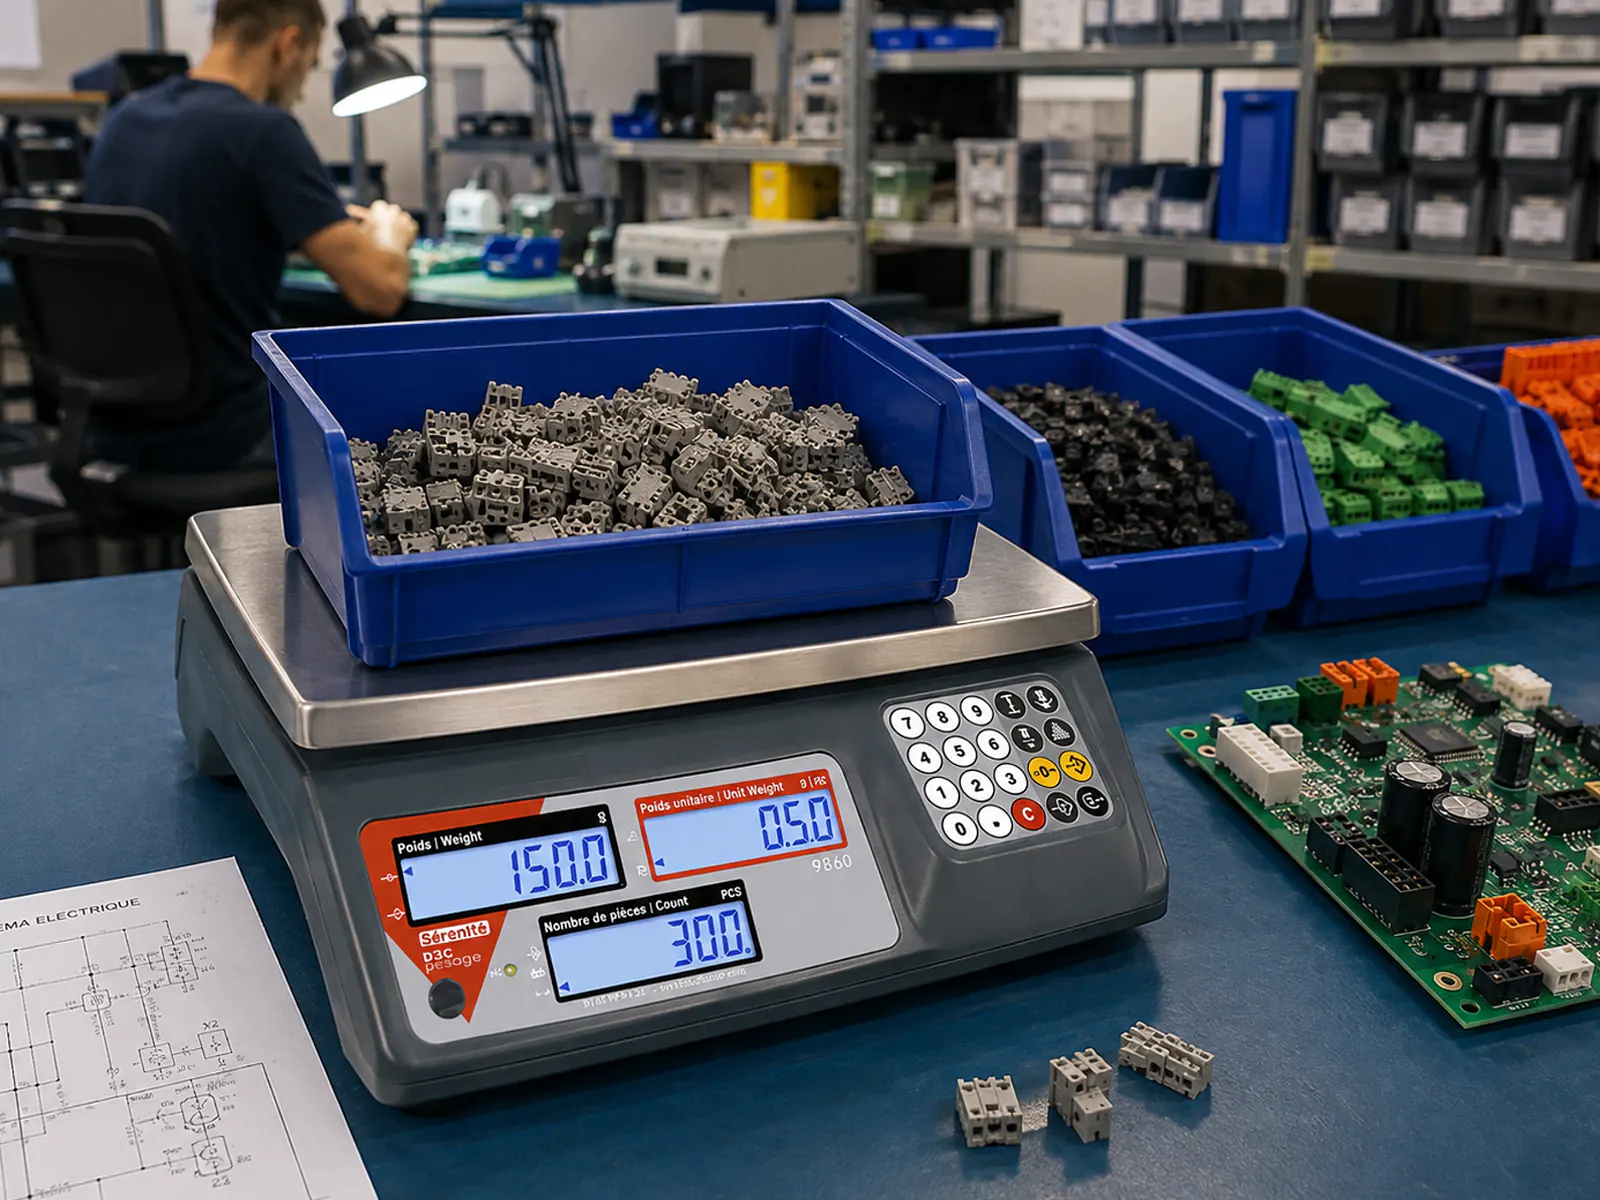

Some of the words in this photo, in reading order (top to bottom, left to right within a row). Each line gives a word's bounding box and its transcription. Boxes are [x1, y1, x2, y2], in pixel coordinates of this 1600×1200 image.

[937, 711, 949, 724] 8
[971, 705, 982, 718] 9
[901, 717, 912, 730] 7
[988, 738, 1000, 750] 6
[920, 751, 931, 764] 4
[954, 745, 965, 758] 5
[971, 779, 983, 792] 2
[1005, 772, 1017, 785] 3
[640, 799, 671, 814] Poids
[673, 793, 715, 809] unitaire
[723, 786, 747, 800] Unit
[747, 781, 785, 797] Weight
[937, 786, 947, 800] 1
[1022, 807, 1035, 821] C
[955, 822, 966, 836] 0
[397, 839, 432, 855] Poids
[440, 830, 483, 847] Weight
[510, 834, 608, 895] 150.0
[812, 854, 852, 872] 9860
[720, 886, 742, 900] PCS
[36, 897, 141, 924] ELECTRIQUE
[543, 916, 590, 933] Nombre
[593, 912, 607, 924] de
[610, 905, 647, 922] pièces
[655, 896, 689, 911] Count
[422, 948, 453, 963] D3C
